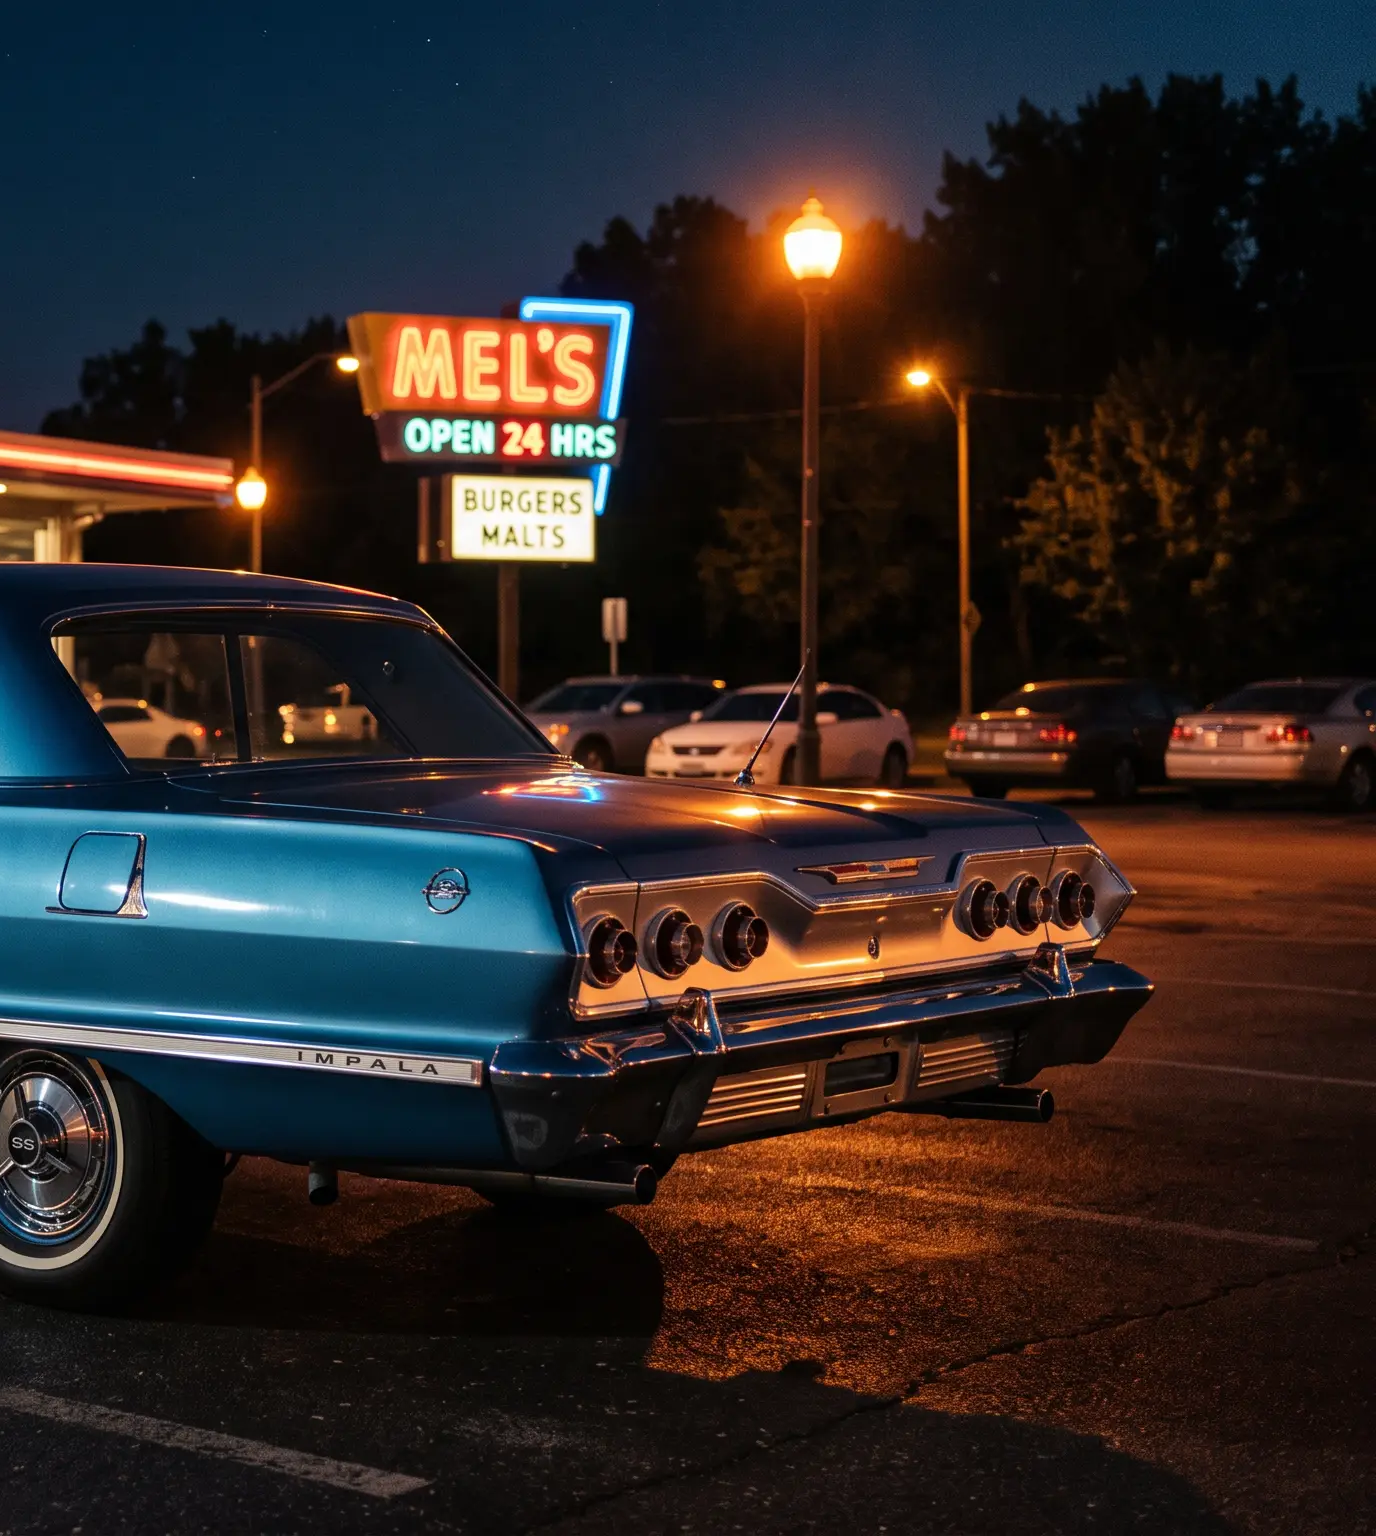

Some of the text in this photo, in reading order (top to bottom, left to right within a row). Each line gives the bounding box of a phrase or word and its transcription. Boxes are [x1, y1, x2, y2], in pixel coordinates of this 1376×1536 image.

[392, 326, 596, 407] MEL'S
[404, 417, 617, 459] OPEN 24 HRS
[463, 488, 583, 516] BURGERS
[481, 525, 566, 549] MALTS
[297, 1050, 439, 1076] IMPALA
[11, 1136, 35, 1151] SS
